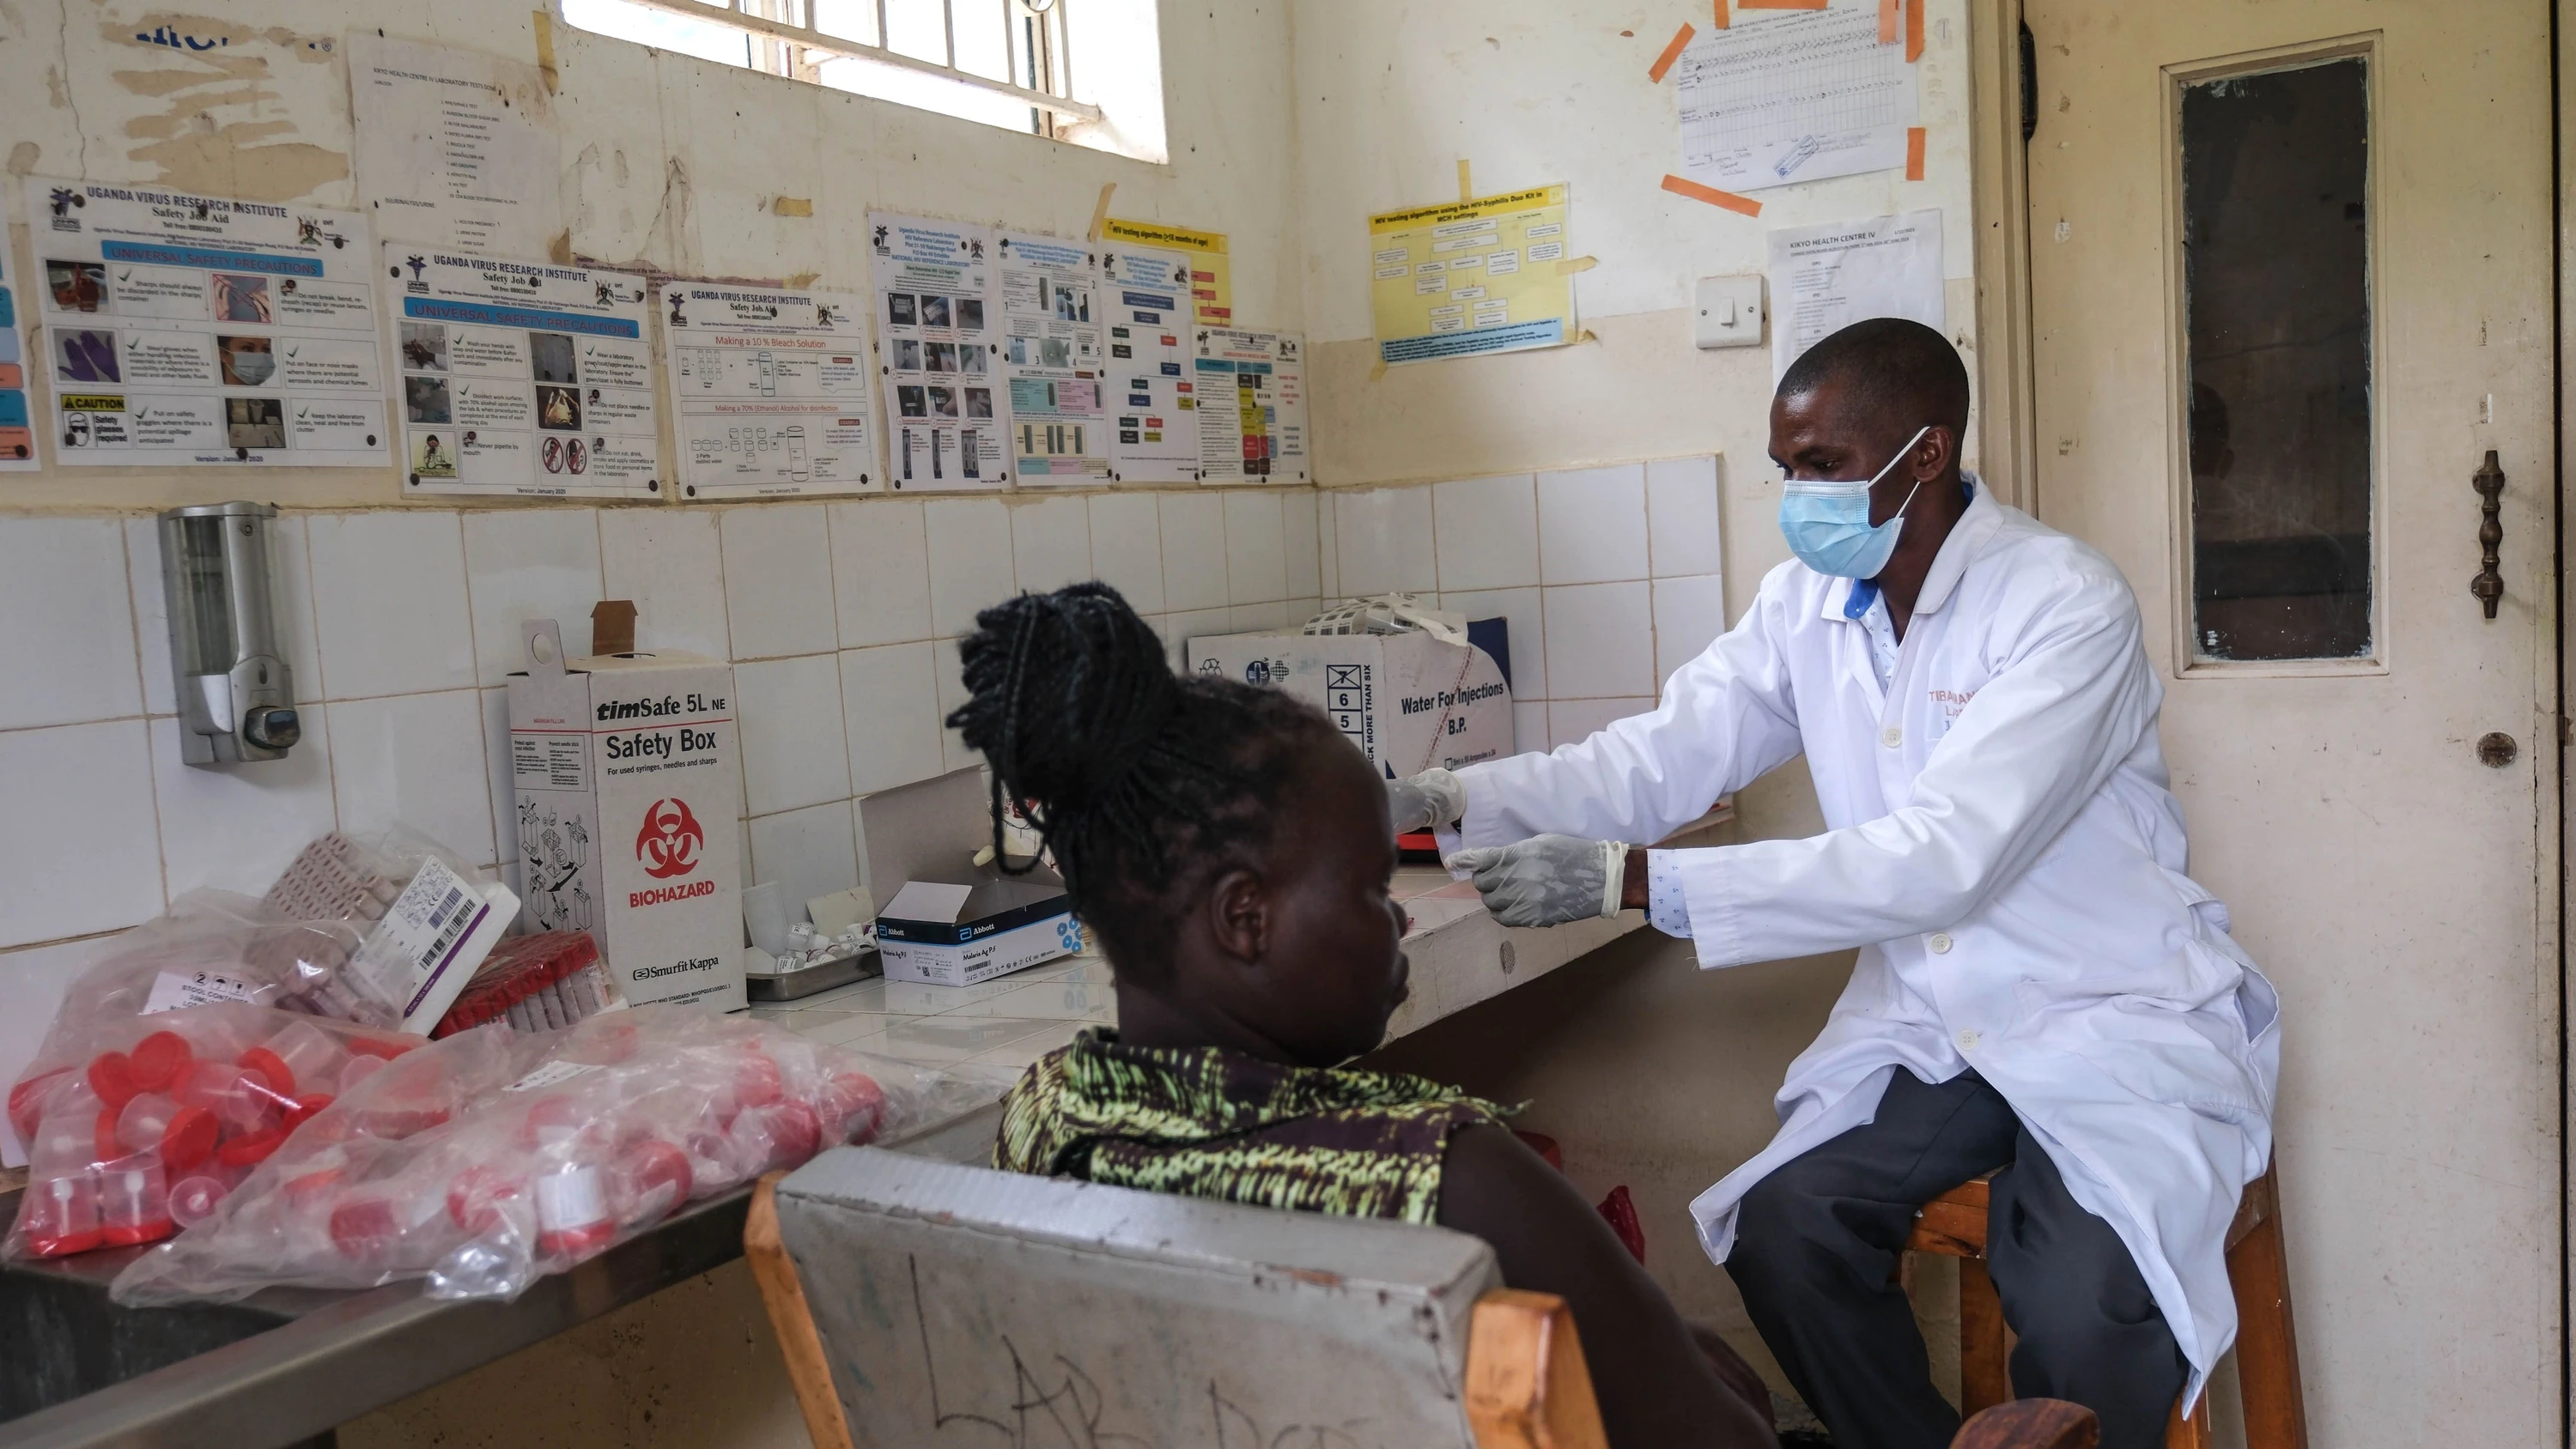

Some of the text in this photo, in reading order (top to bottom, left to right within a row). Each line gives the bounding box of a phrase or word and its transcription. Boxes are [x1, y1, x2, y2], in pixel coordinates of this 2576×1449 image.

[389, 70, 409, 78] HEALTH
[409, 72, 429, 82] CENTRE
[435, 77, 469, 87] LABORATORY
[86, 186, 289, 218] UGANDA VIRUS RESEARCH INSTITUTE
[1388, 215, 1408, 223] testing
[1410, 209, 1439, 220] algorithm
[1441, 207, 1458, 215] using
[1470, 197, 1509, 209] HIV-Syphilis
[152, 206, 185, 221] Safety
[211, 213, 229, 223] Aid
[1437, 212, 1479, 223] MCH settings
[1122, 228, 1139, 238] testing
[1140, 230, 1163, 239] algorithm
[1790, 240, 1811, 249] KIKYO
[1813, 237, 1838, 246] HEALTH
[1840, 233, 1867, 242] CENTRE
[112, 249, 318, 275] UNIVERSAL SAFETY PRECAUTIONS
[434, 255, 470, 269] UGANDA
[471, 259, 497, 271] VIRUS
[500, 264, 542, 276] RESEARCH
[545, 269, 587, 282] INSTITUTE
[483, 273, 508, 283] Safety
[511, 276, 526, 285] Job
[691, 290, 811, 306] UGANDA VIRUS RESEARCH INSTITUTE
[730, 303, 750, 312] Safety
[415, 304, 633, 336] UNIVERSAL SAFETY PRECAUTIONS
[716, 336, 744, 347] Making
[771, 339, 795, 348] Bleach
[797, 340, 826, 349] Solution
[1097, 347, 1101, 355] 5
[1036, 355, 1040, 364] 3
[76, 398, 125, 409] CAUTION
[95, 415, 118, 425] Safety
[98, 434, 128, 443] required
[1340, 694, 1348, 706] 6
[1401, 682, 1504, 715] Water For Injections
[598, 694, 726, 721] timSafe 5L NE
[1341, 716, 1349, 728] 5
[1448, 718, 1467, 735] B.P.
[607, 729, 716, 759] Safety Box
[620, 766, 635, 774] used
[636, 763, 662, 773] syringes,
[699, 757, 717, 766] sharps
[629, 880, 715, 908] BIOHAZARD
[974, 924, 995, 935] Abbott
[963, 949, 981, 961] Malaria
[651, 956, 719, 979] Smurfit Kappa
